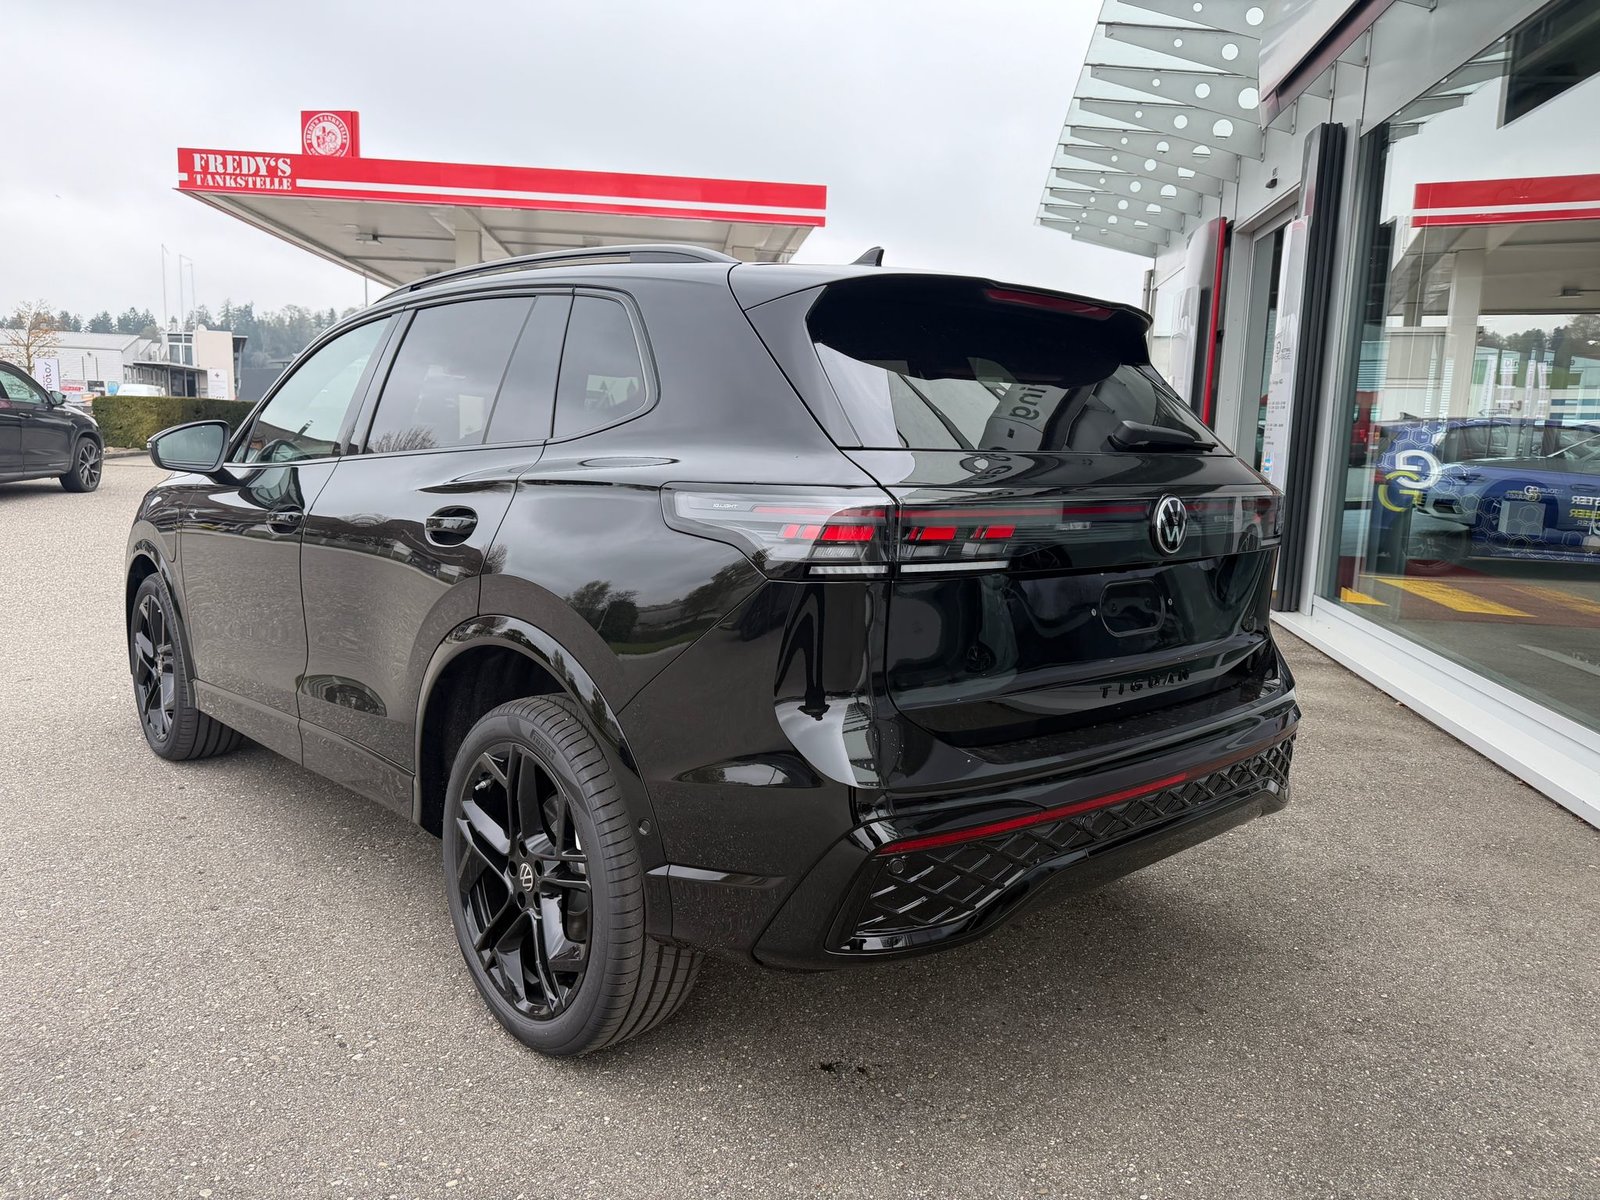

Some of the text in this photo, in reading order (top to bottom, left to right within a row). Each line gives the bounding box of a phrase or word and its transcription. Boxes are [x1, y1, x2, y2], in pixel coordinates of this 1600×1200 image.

[193, 153, 292, 176] FREDY'S
[194, 174, 292, 190] TANKSTELLE
[1100, 668, 1191, 698] TIGUAN
